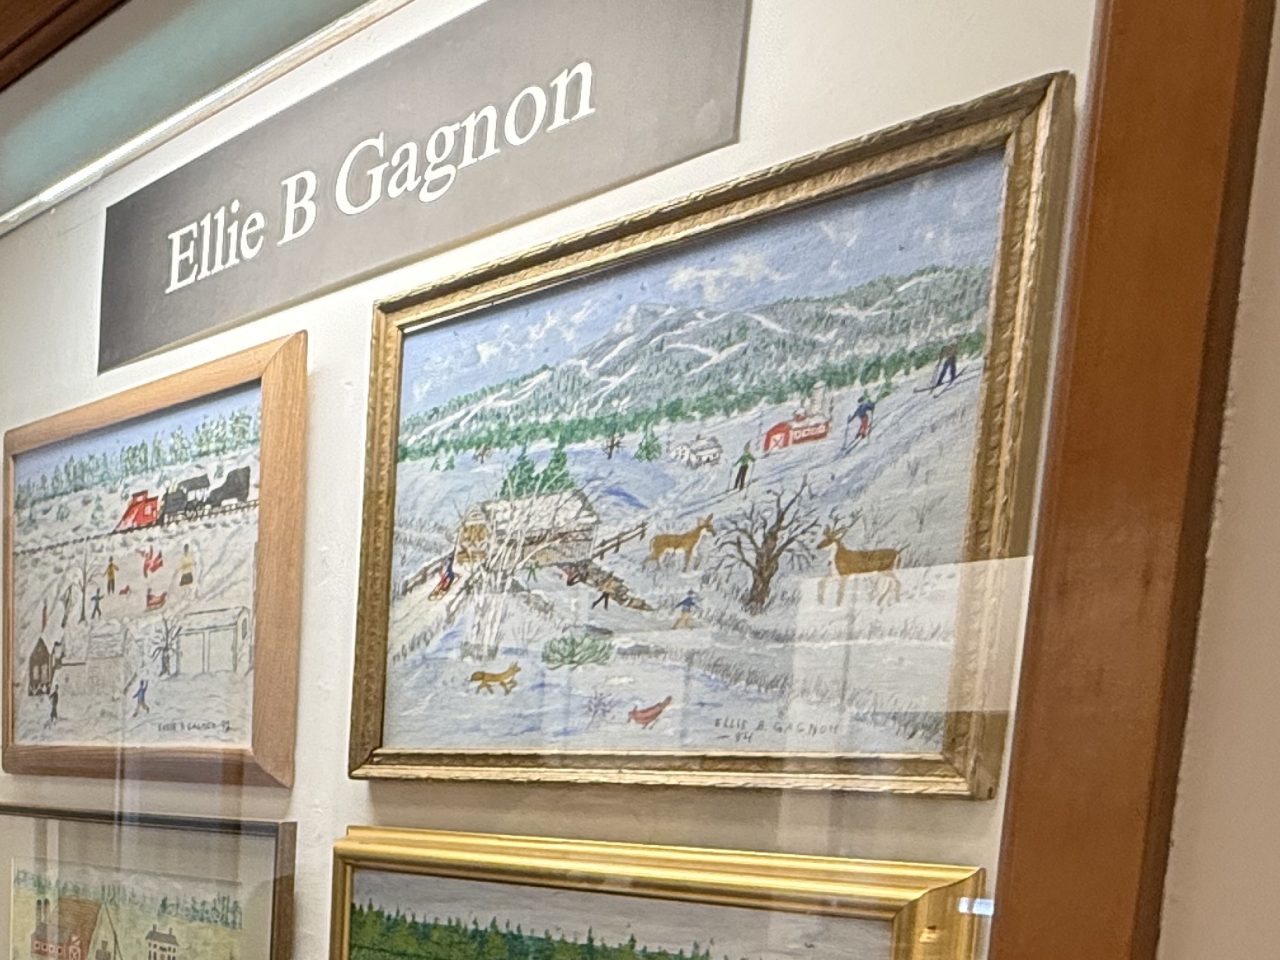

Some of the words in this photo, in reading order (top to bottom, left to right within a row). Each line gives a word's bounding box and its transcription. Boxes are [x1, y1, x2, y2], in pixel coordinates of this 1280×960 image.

[165, 199, 265, 294] Ellie
[278, 169, 319, 245] B
[335, 59, 596, 215] Gagnon
